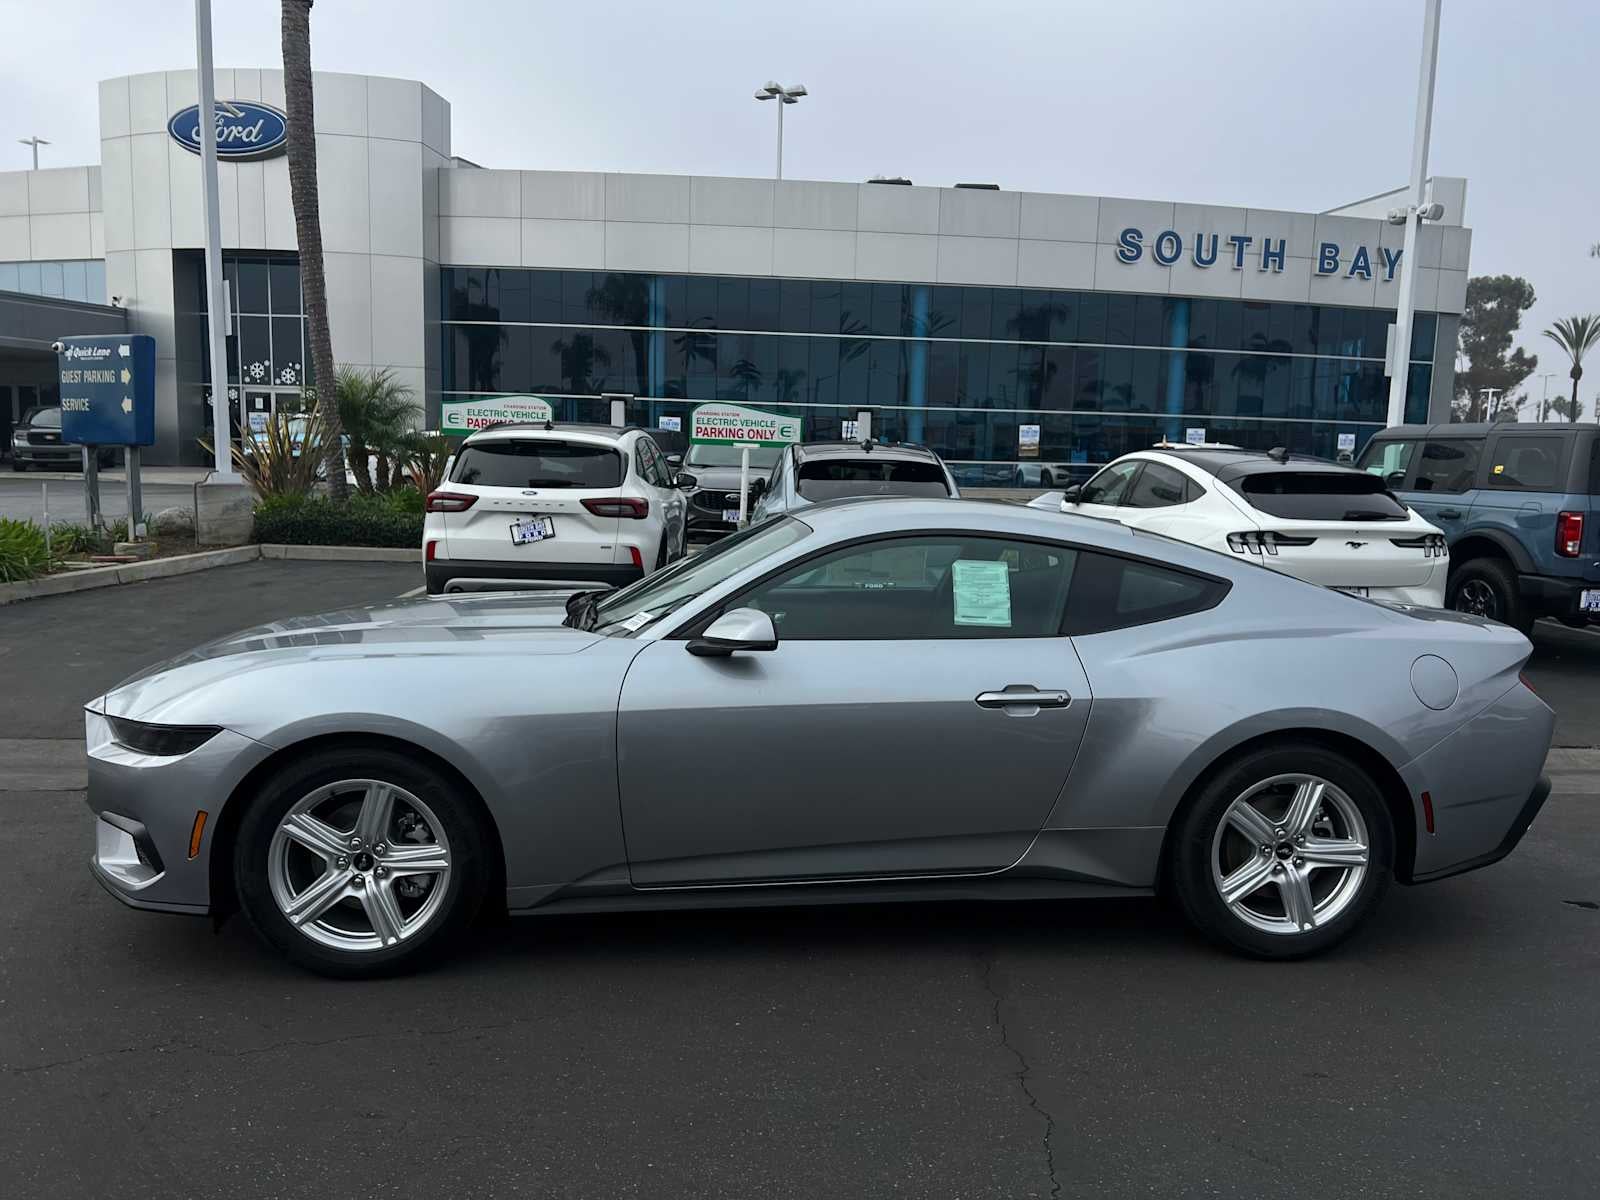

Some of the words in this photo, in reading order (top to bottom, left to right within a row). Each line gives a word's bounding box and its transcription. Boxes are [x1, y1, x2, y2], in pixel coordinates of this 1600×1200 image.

[191, 102, 264, 142] Ford
[1117, 228, 1287, 273] SOUTH
[1315, 242, 1403, 281] BAY
[73, 346, 93, 357] Quick
[93, 346, 111, 356] Lane
[62, 370, 81, 383] GUEST
[84, 370, 116, 383] PARKING
[62, 398, 90, 411] SERVICE
[467, 408, 507, 418] ELECTRIC
[511, 410, 547, 419] VEHICLE
[696, 417, 738, 426] ELECTRIC
[740, 420, 776, 428] VEHICLE
[696, 427, 744, 438] PARKING
[747, 429, 776, 440] ONLY
